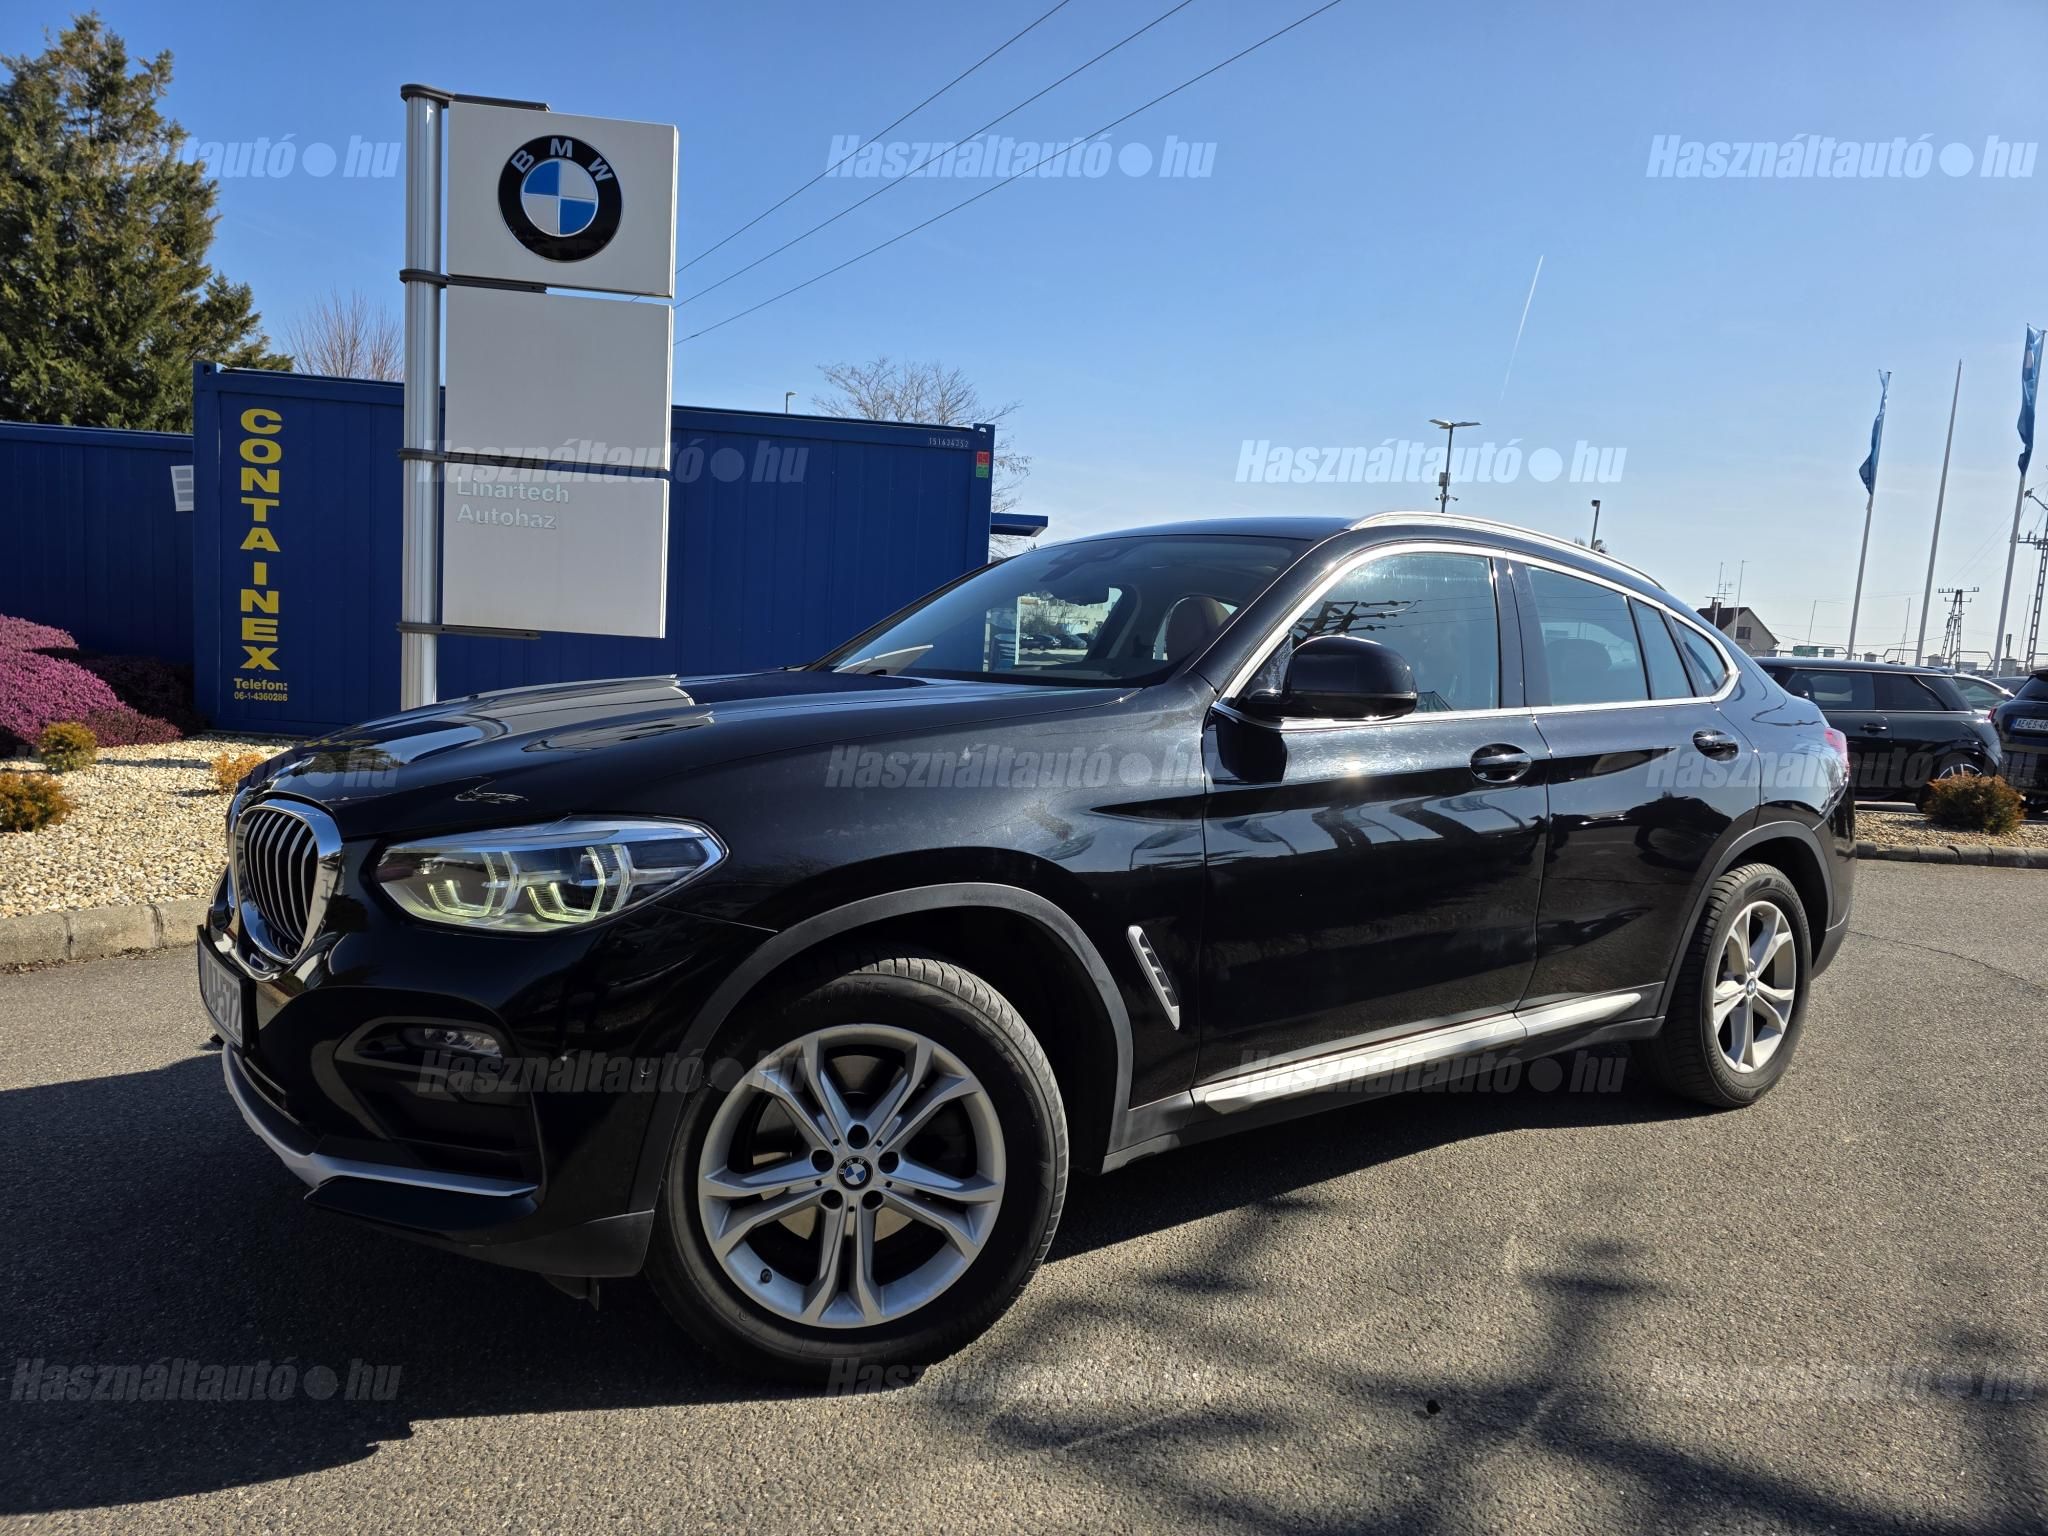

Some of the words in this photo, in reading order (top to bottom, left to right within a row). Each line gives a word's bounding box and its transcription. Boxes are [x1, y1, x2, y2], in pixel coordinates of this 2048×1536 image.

[511, 138, 613, 181] BMW
[457, 476, 569, 503] Linartech
[456, 503, 557, 529] Autohaz
[240, 408, 282, 671] CONTAINEX
[233, 677, 288, 691] Telefon:
